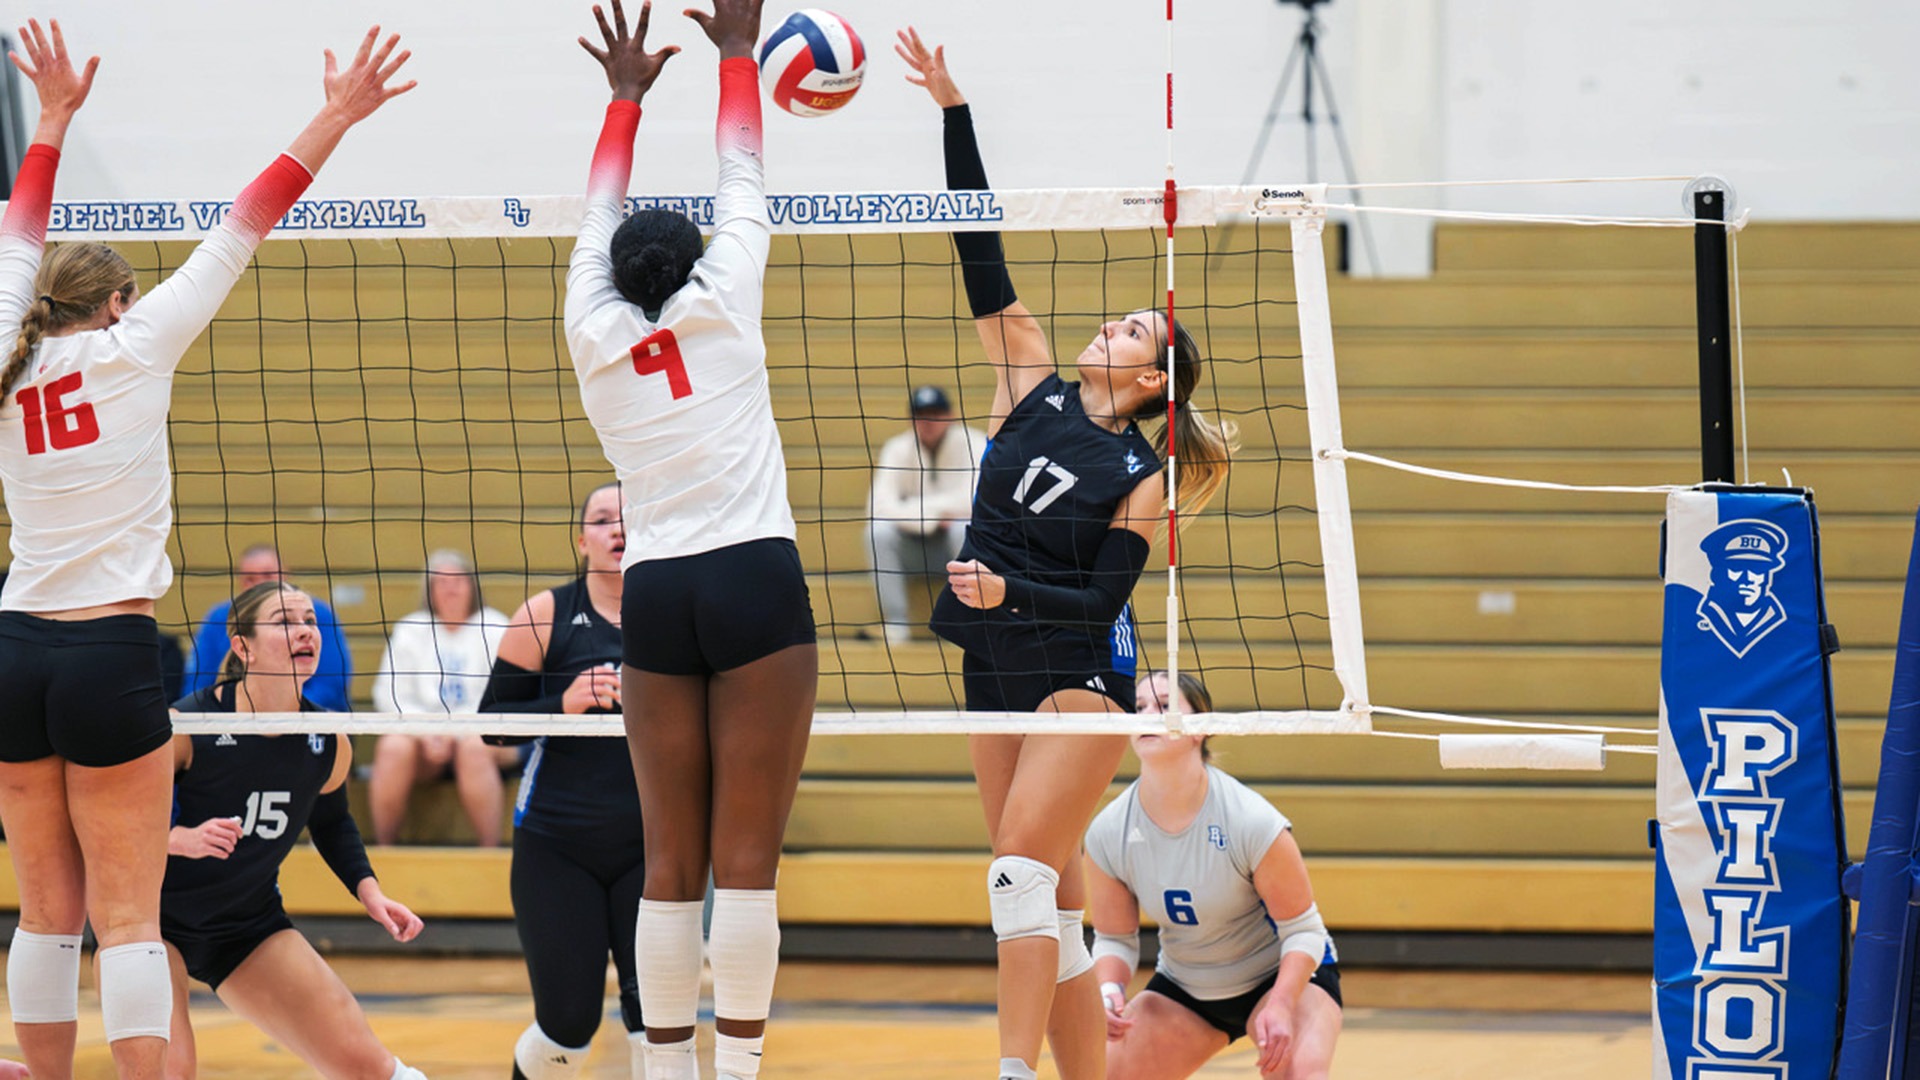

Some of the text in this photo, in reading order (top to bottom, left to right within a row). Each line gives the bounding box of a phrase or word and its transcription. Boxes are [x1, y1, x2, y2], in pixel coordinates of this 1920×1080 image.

[765, 193, 1003, 224] VOLLEYBALL
[1271, 190, 1304, 198] Senoh
[46, 199, 425, 231] BETHEL VEYBALL
[504, 198, 530, 227] BU
[630, 328, 693, 401] 9
[15, 370, 101, 455] 16
[1012, 455, 1079, 514] 17
[1740, 536, 1761, 549] BU
[243, 791, 291, 839] 15
[1208, 825, 1226, 850] BU
[1163, 889, 1199, 925] 6
[1686, 708, 1798, 1080] PILO
